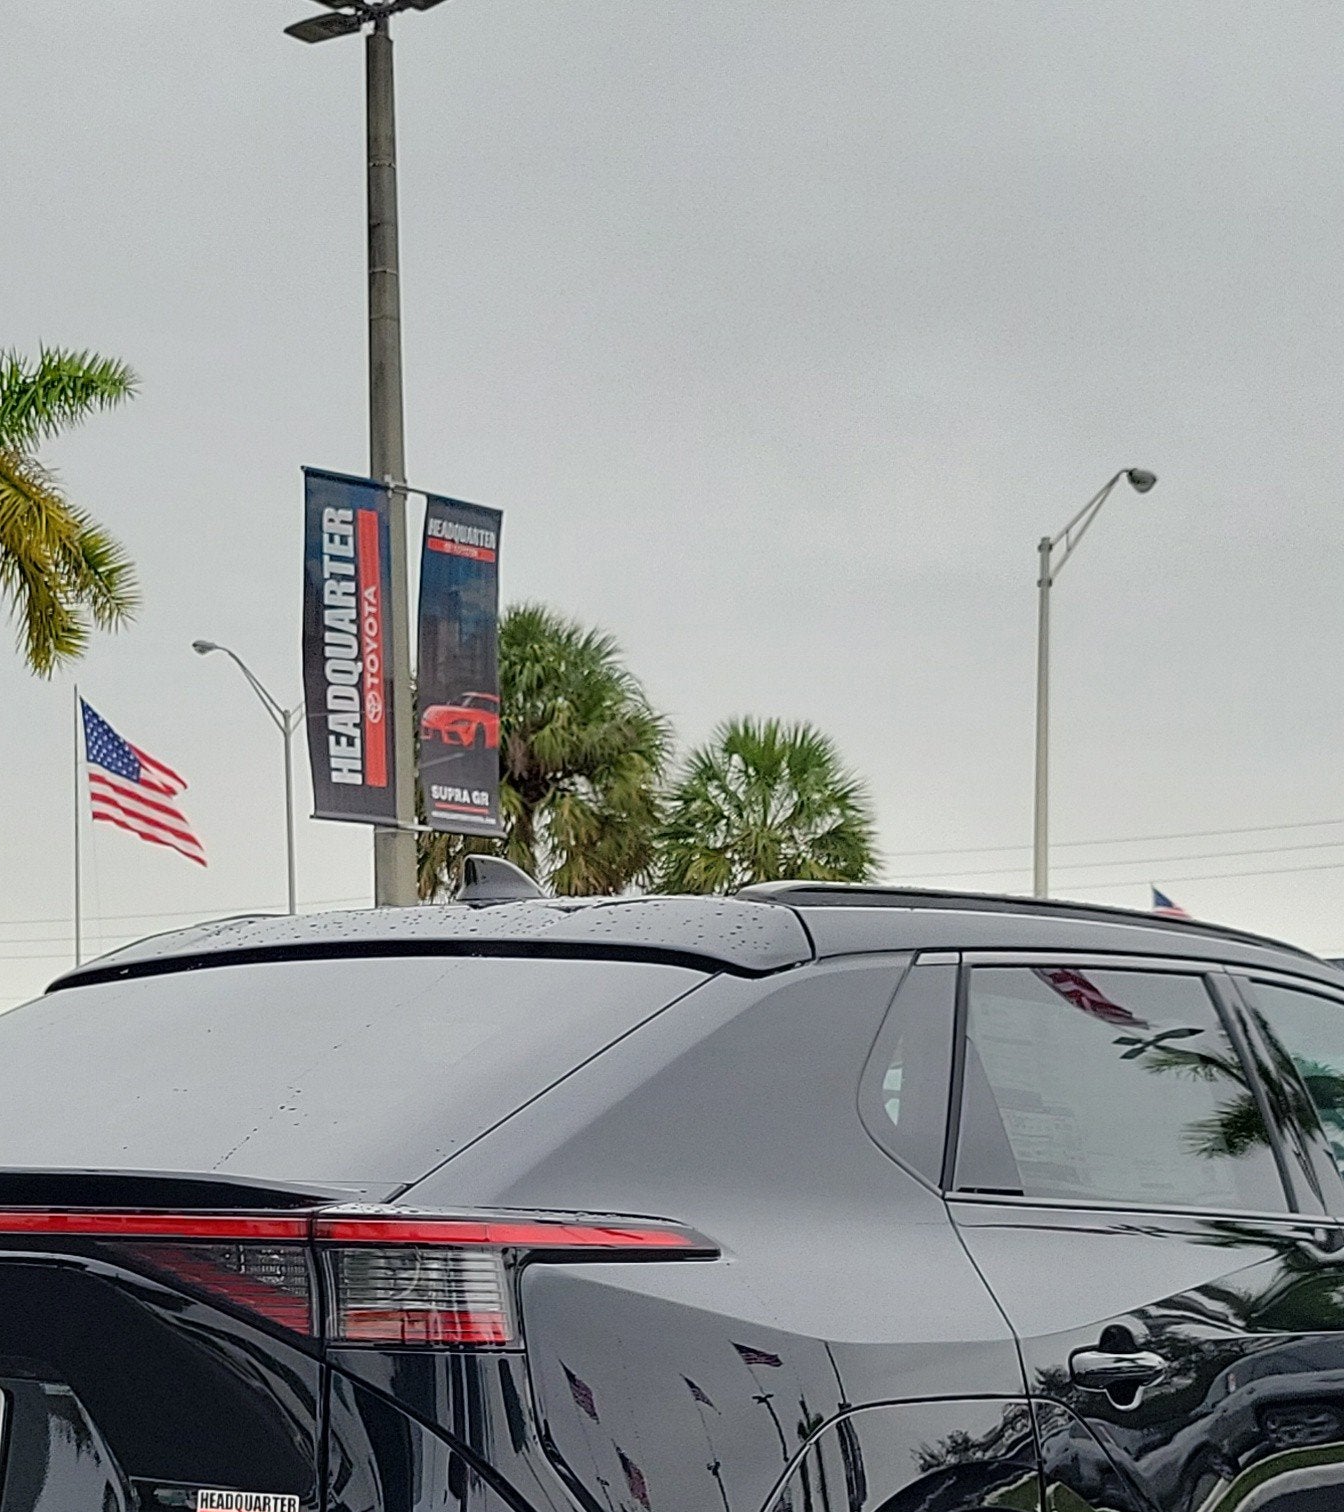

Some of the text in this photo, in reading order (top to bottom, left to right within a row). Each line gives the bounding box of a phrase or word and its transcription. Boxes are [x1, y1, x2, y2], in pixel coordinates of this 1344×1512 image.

[427, 518, 496, 549] HEADQUARTER
[322, 507, 363, 786] HEADQUARTER
[363, 585, 380, 689] TOYOTA
[431, 784, 490, 806] SUPRA GR
